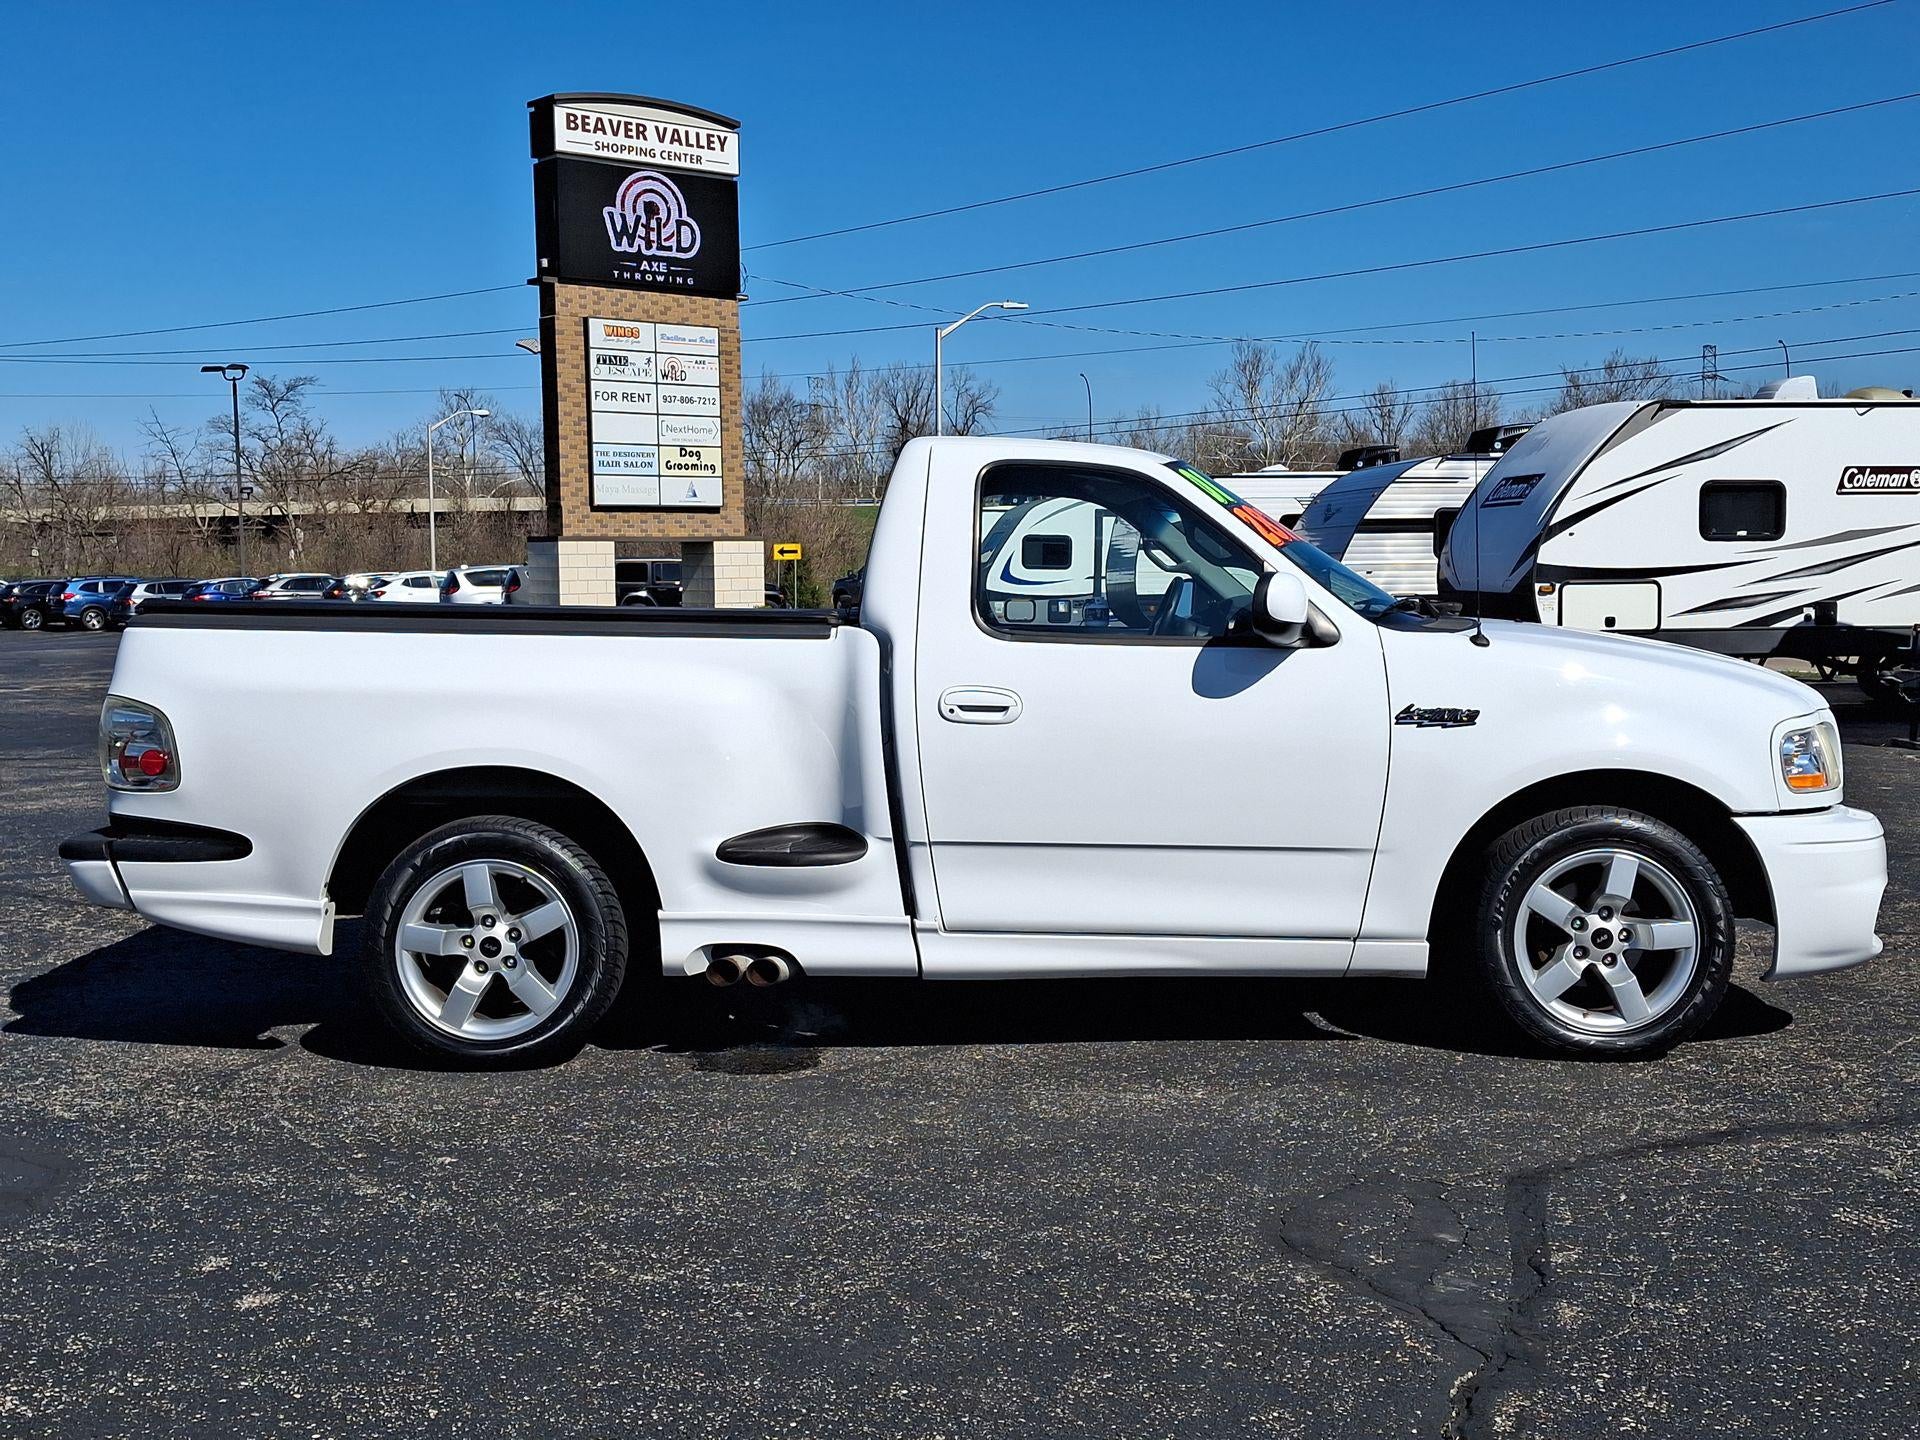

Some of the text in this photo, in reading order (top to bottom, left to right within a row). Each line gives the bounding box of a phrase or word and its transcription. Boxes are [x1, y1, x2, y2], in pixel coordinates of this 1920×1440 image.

[565, 112, 729, 152] BEAVER VALLEY
[594, 140, 703, 165] SHOPPING CENTER
[606, 209, 698, 256] WILD
[639, 260, 668, 273] AXE
[613, 270, 695, 285] THROWING
[603, 325, 640, 338] WINGS
[597, 354, 628, 366] TIME
[608, 366, 652, 378] ESCAPE
[660, 368, 687, 381] WILD
[594, 390, 652, 404] FOR RENT
[662, 394, 717, 406] 937-806-7212
[665, 423, 713, 435] NextHome
[679, 447, 702, 461] Dog
[623, 461, 654, 469] SALON
[665, 460, 717, 475] Grooming
[1843, 468, 1909, 488] Coleman
[596, 484, 657, 496] Maya Massage
